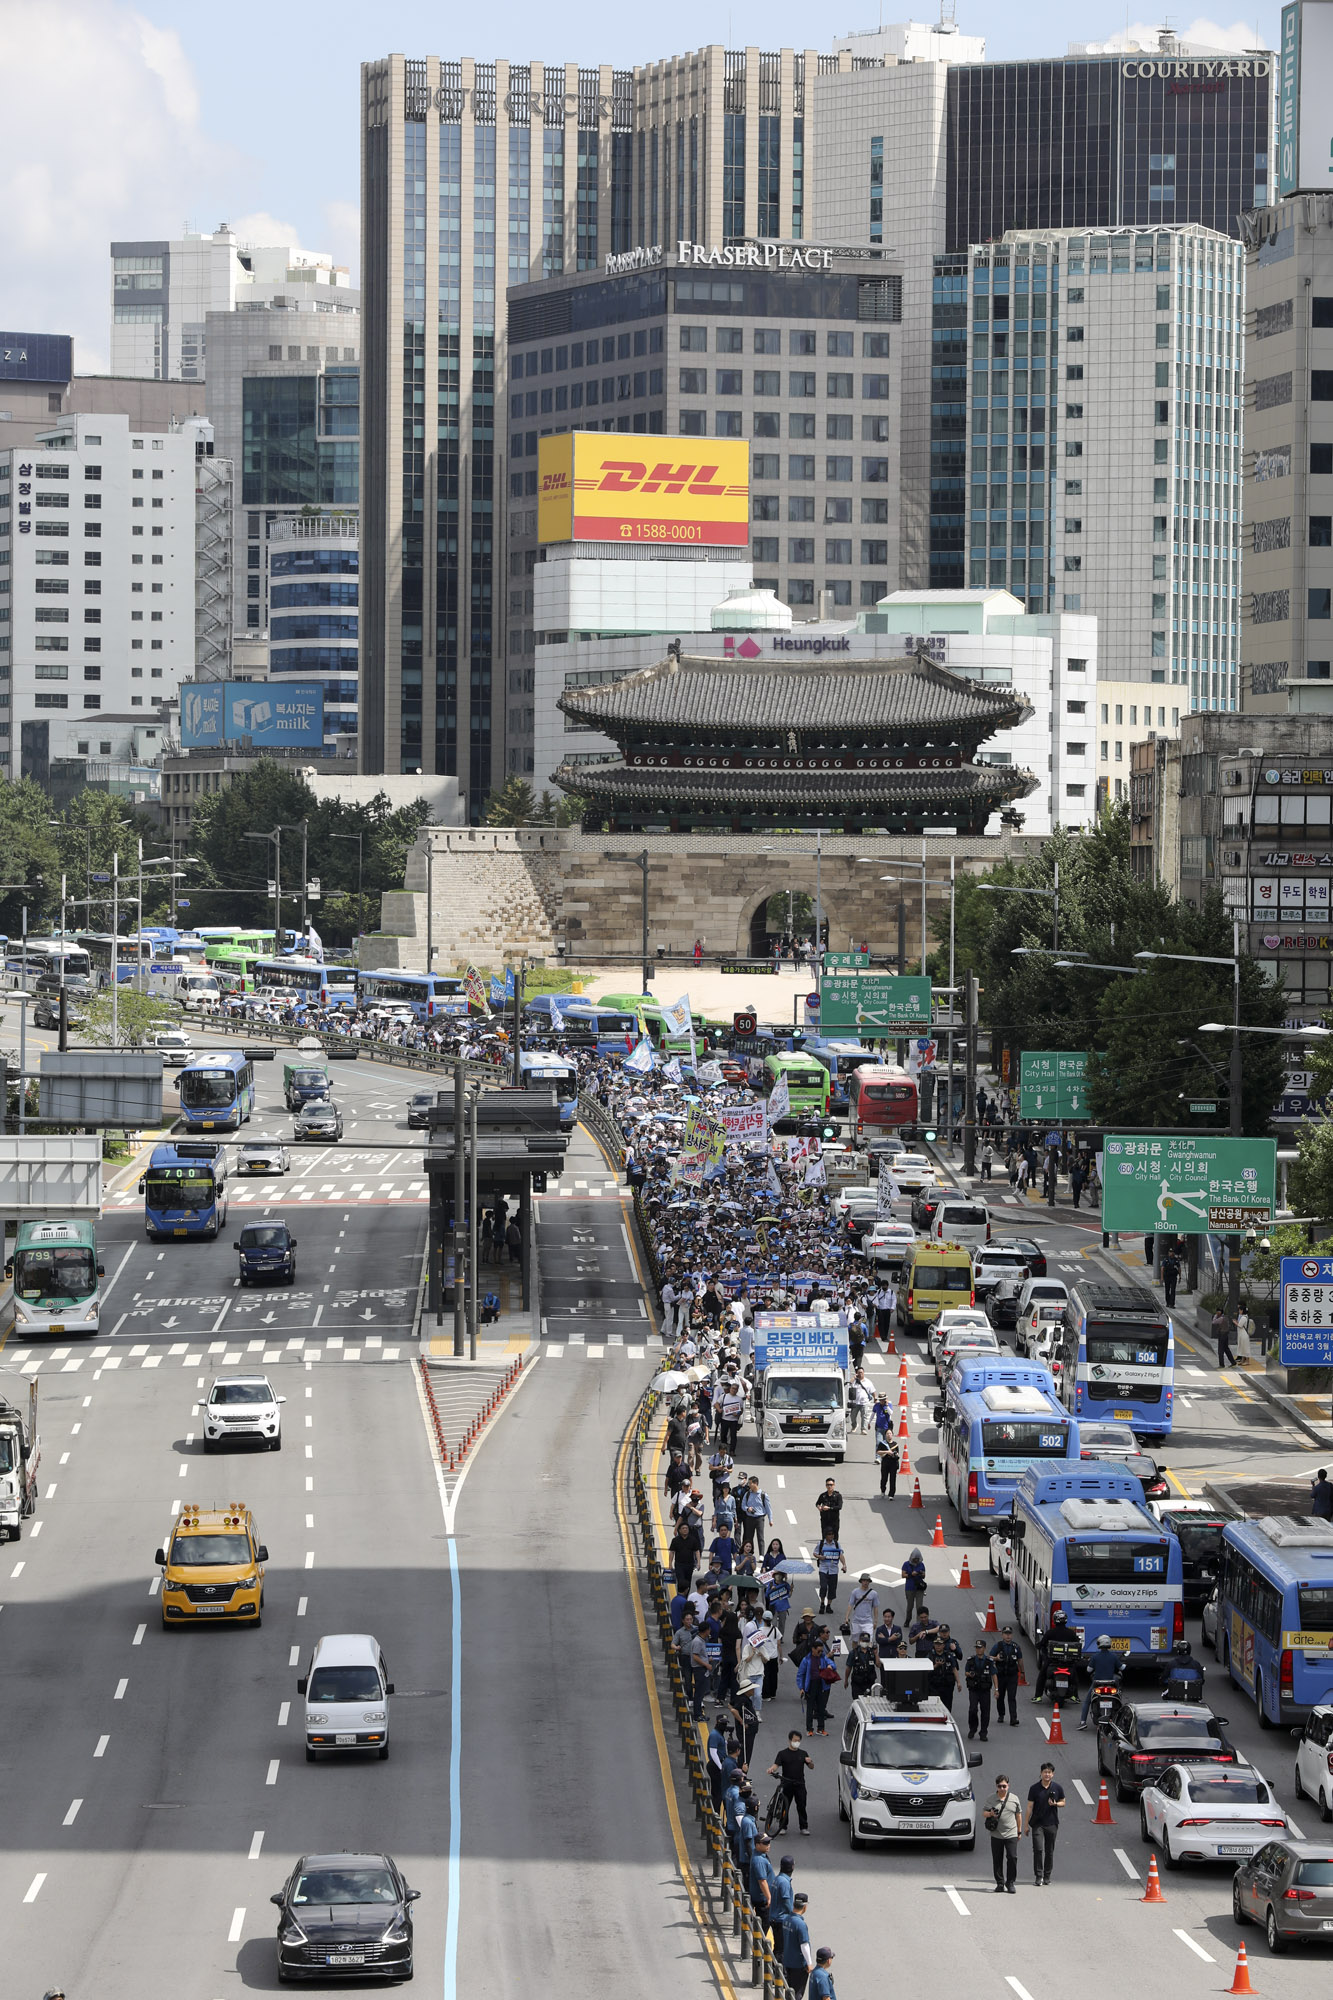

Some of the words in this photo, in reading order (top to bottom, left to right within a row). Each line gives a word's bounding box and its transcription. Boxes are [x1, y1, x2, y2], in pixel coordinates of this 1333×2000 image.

[1122, 60, 1270, 79] COURTYARD
[414, 86, 498, 111] HOTEL
[504, 90, 624, 118] GRACERY
[542, 472, 568, 491] DHL
[597, 460, 727, 496] DHL
[18, 463, 33, 534] 삼정빌딩
[636, 524, 702, 540] 1588-0001
[773, 636, 851, 654] Heungkuk
[276, 703, 316, 715] 복사지는
[276, 716, 311, 730] miilk
[1282, 770, 1301, 784] 승리
[1303, 770, 1324, 784] 인력
[1264, 852, 1290, 866] 사교
[1291, 853, 1317, 867] 댄스
[1259, 885, 1273, 899] 영
[1282, 886, 1302, 898] 무도
[1308, 886, 1328, 899] 학원
[830, 955, 864, 965] 숭례문
[833, 980, 859, 989] 광화문
[889, 1003, 920, 1012] 한국은행
[739, 1020, 751, 1029] 50
[1031, 1060, 1050, 1069] 시청
[1059, 1060, 1088, 1069] 한국은
[191, 1071, 203, 1079] 104
[1025, 1070, 1040, 1078] City
[1124, 1142, 1163, 1156] 광화문
[1168, 1140, 1196, 1150] 光化門
[1167, 1150, 1217, 1160] Gwanghwamun
[164, 1169, 196, 1178] 700
[1135, 1173, 1148, 1181] City
[1169, 1174, 1182, 1182] City
[1209, 1180, 1258, 1193] 한국은행
[1209, 1194, 1221, 1202] The
[1223, 1195, 1240, 1203] Bank
[1241, 1195, 1249, 1203] Of
[1251, 1195, 1271, 1204] Korea
[1210, 1208, 1242, 1220] 남산공원
[1154, 1221, 1178, 1231] 180m
[1209, 1221, 1238, 1229] Namsan
[28, 1251, 50, 1261] 799
[1288, 1287, 1324, 1303] 총중량
[1288, 1309, 1323, 1324] 축하중
[767, 1331, 806, 1345] 모두의
[808, 1331, 838, 1346] 바다,
[1285, 1333, 1314, 1341] 남산육교
[766, 1346, 796, 1357] 우리가
[796, 1346, 839, 1357] 지킵시다!
[1286, 1342, 1315, 1350] 2004년
[1317, 1342, 1329, 1350] 3월
[1138, 1352, 1156, 1363] 504
[1124, 1371, 1144, 1379] Galaxy
[1041, 1435, 1062, 1448] 502
[1138, 1558, 1161, 1571] 151
[1110, 1589, 1137, 1599] Galaxy
[1142, 1589, 1159, 1599] Flip5
